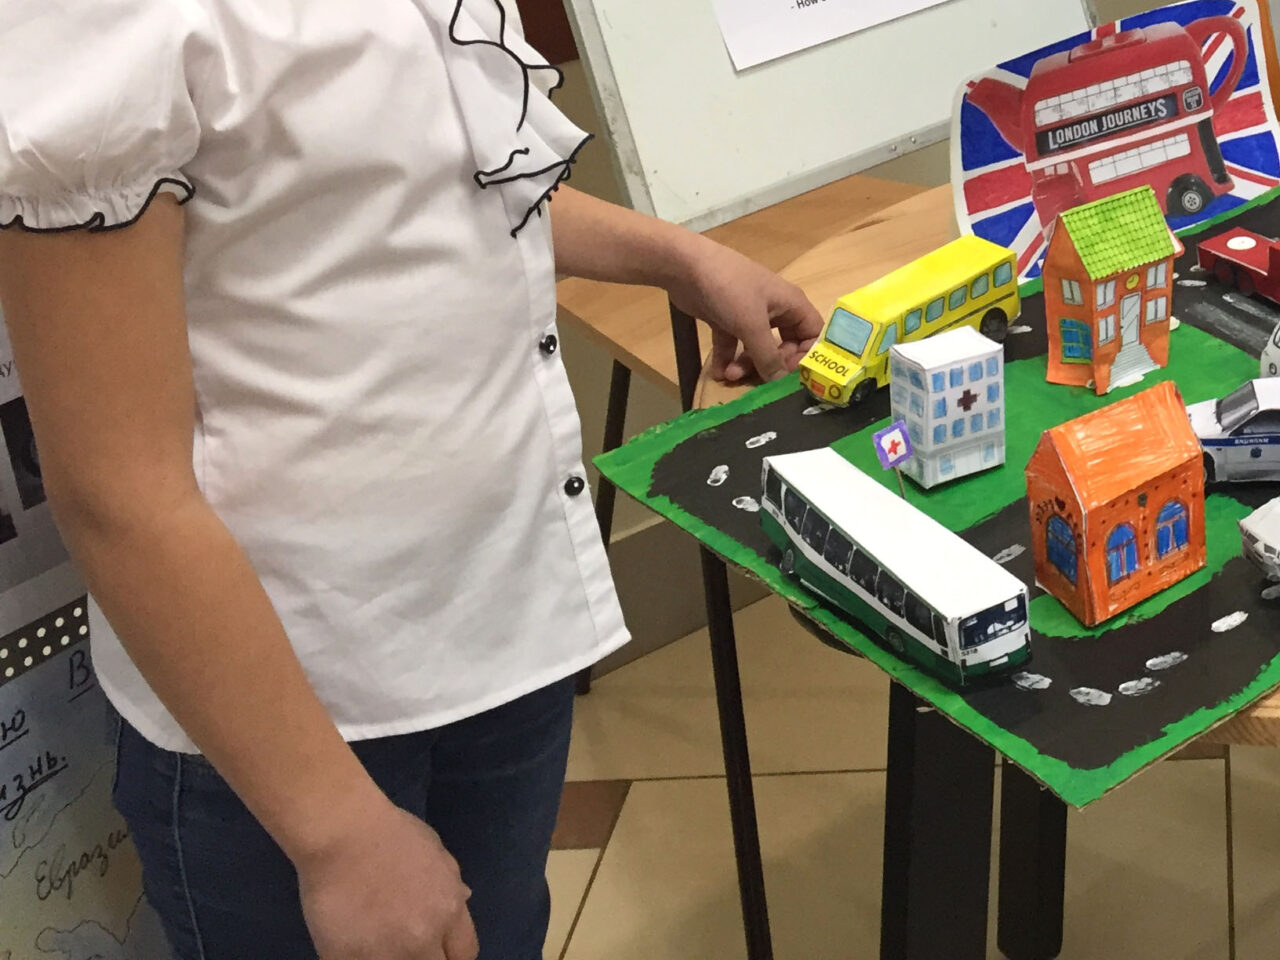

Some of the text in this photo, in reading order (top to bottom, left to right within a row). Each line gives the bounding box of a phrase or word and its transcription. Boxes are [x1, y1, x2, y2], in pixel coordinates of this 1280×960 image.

[1048, 119, 1099, 150] LONDON
[1102, 98, 1168, 131] JOURNEYS
[809, 351, 850, 377] SCHOOL
[35, 828, 129, 901] Еврази
